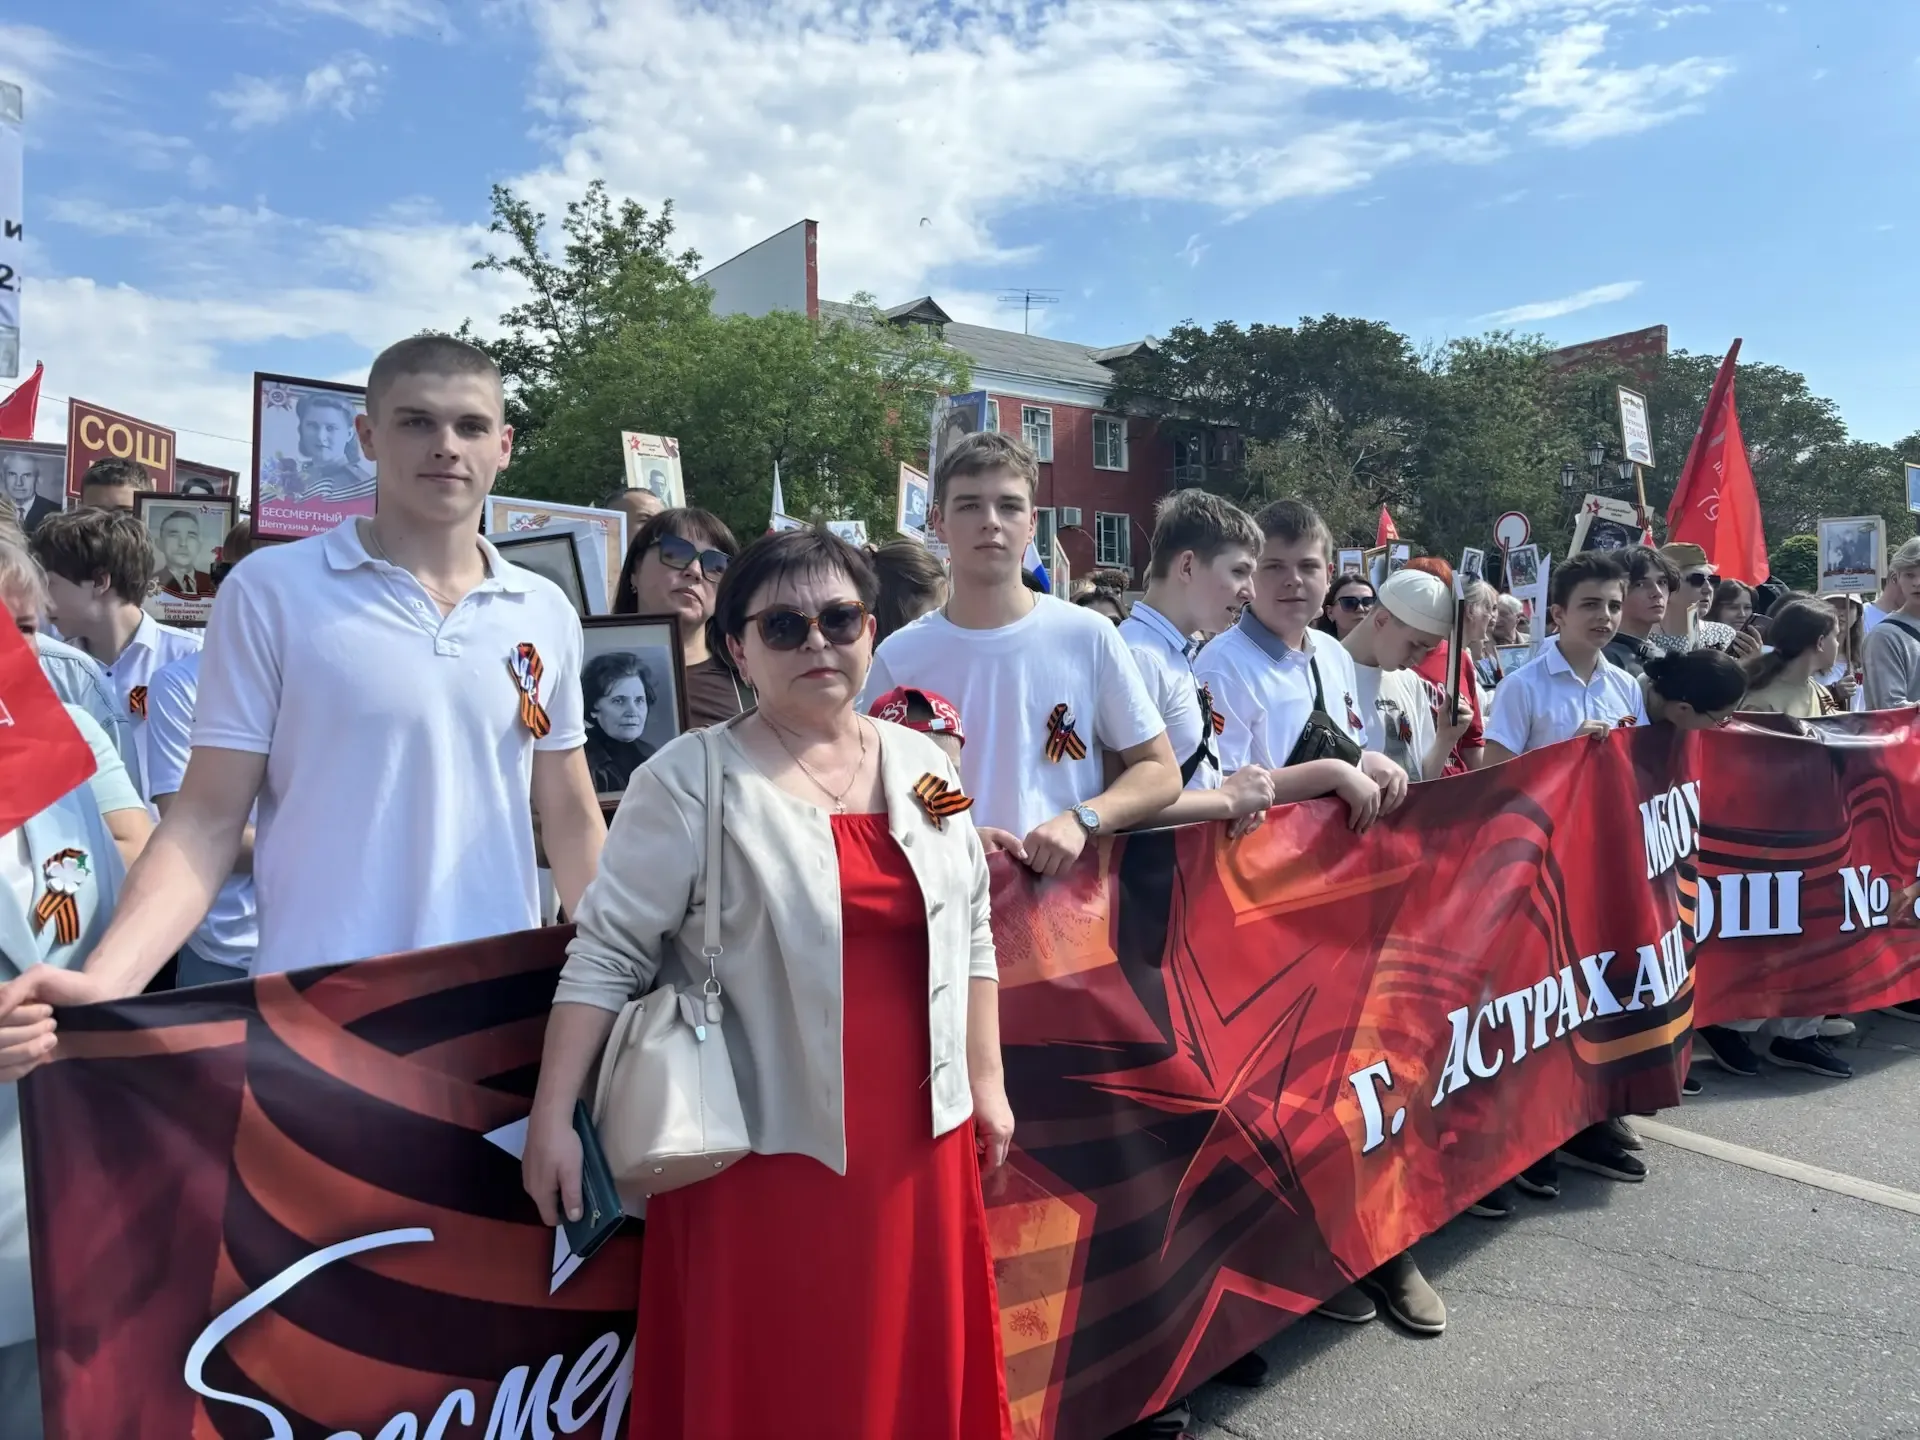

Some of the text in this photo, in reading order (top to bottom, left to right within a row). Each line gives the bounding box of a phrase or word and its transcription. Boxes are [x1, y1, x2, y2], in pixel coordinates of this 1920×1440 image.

[79, 415, 167, 471] СОШ
[258, 520, 308, 531] Шептухина
[262, 507, 342, 522] БЕССМЕРТНЫЙ
[1348, 1058, 1406, 1156] Г.
[1431, 919, 1689, 1108] АСТРАХАНИ
[1837, 864, 1890, 932] №
